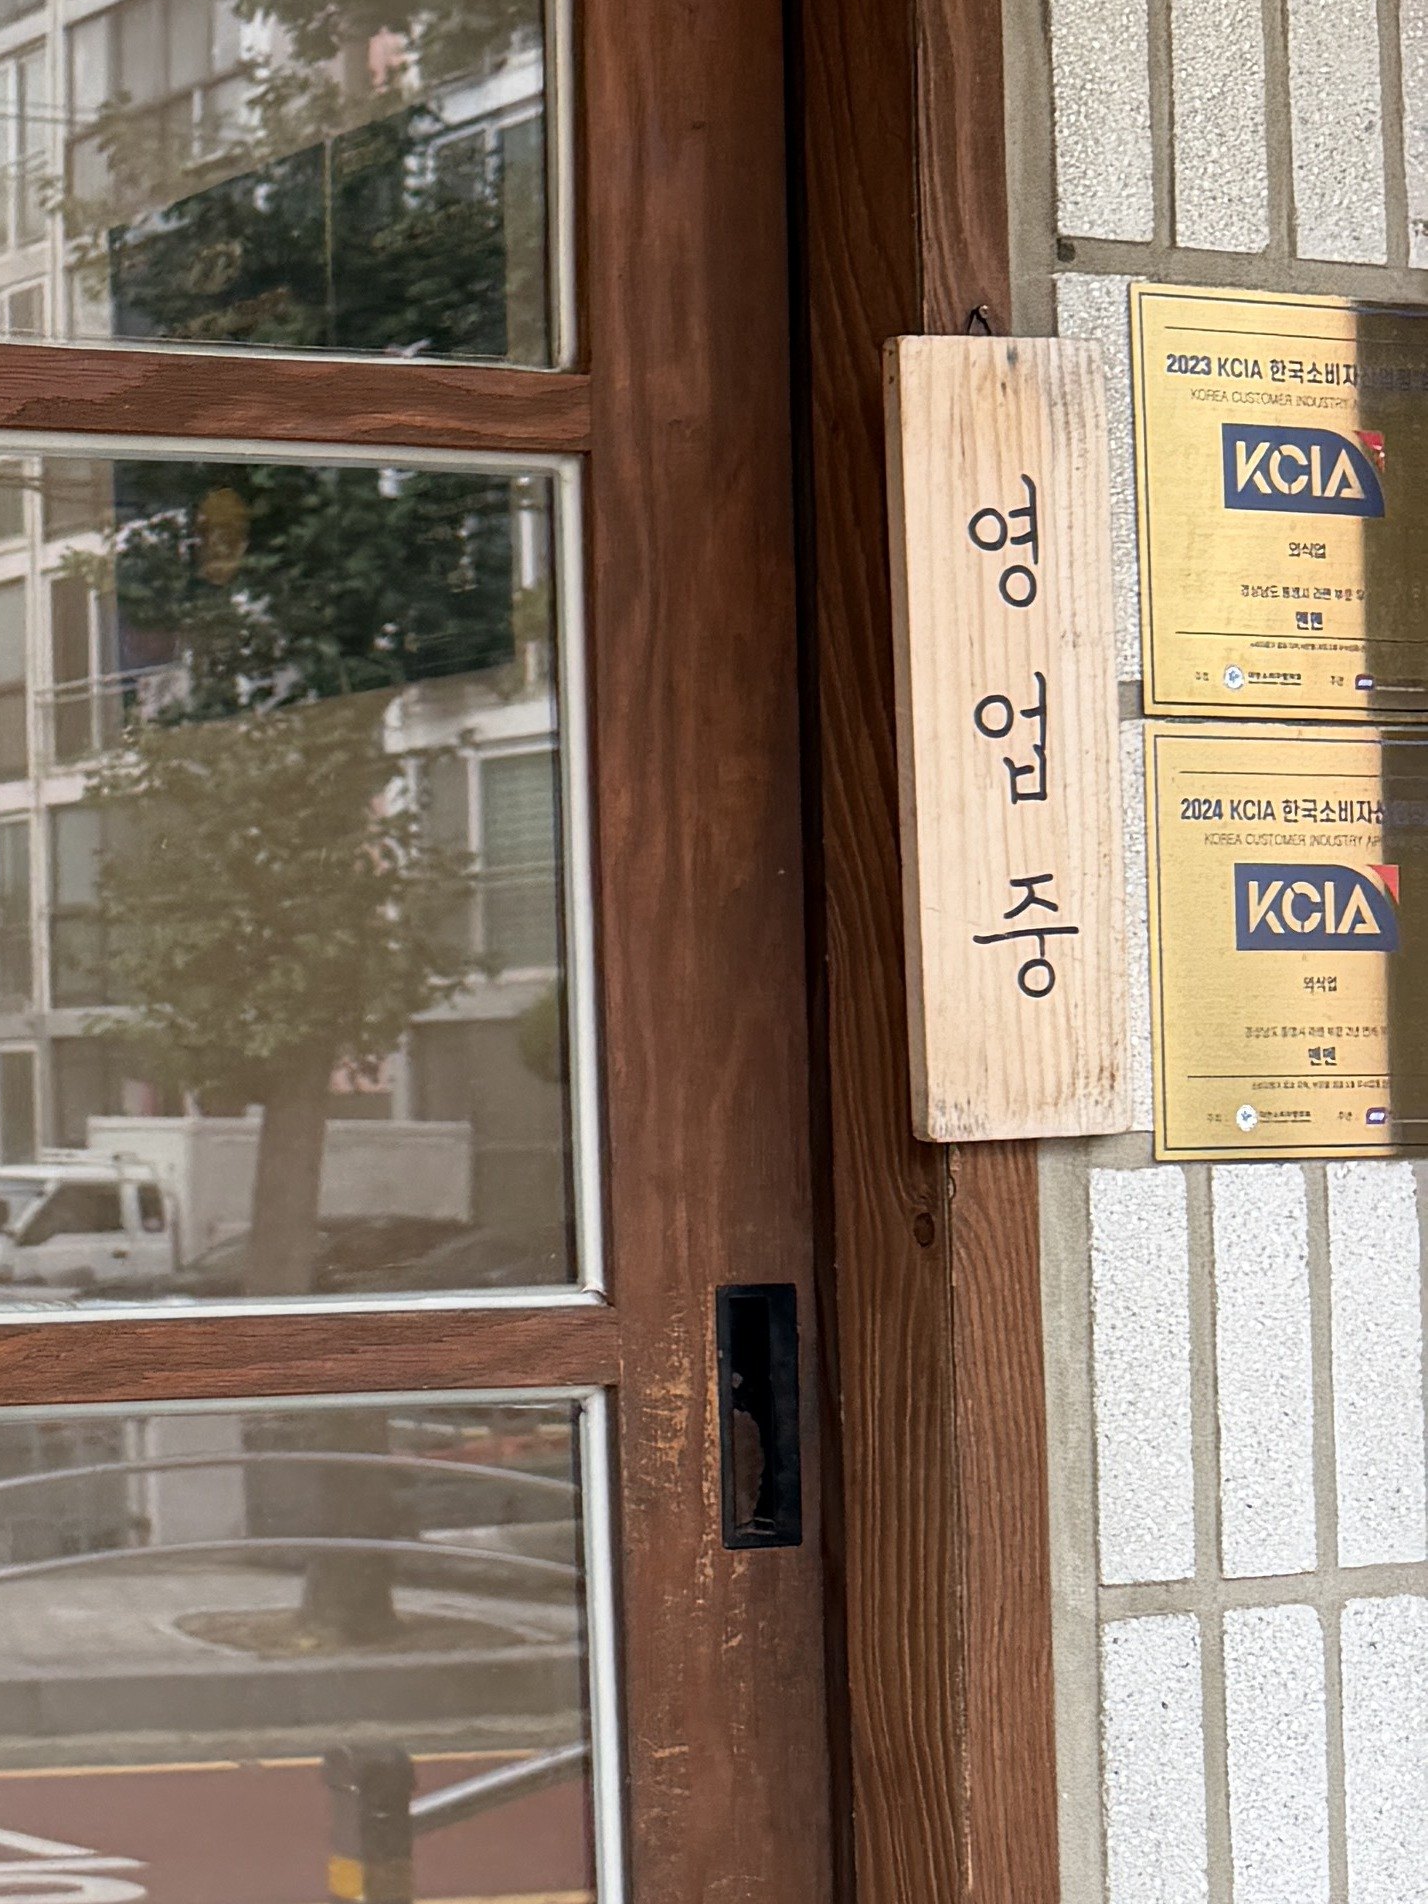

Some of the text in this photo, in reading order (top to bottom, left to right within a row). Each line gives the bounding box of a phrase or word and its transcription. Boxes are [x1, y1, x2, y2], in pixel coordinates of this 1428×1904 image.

[1165, 353, 1212, 376] 2023
[1217, 356, 1263, 380] KCIA
[1190, 388, 1229, 403] KOREA
[1231, 390, 1294, 408] CUSTOMER
[1235, 439, 1366, 500] KCIA
[1288, 541, 1327, 560] 외식업
[967, 473, 1079, 999] 영업중
[1179, 797, 1224, 821] 2024
[1229, 798, 1277, 822] KCIA
[1203, 832, 1243, 846] KOREA
[1244, 832, 1307, 847] CUSTOMER
[1309, 833, 1363, 848] INDUSTRY
[1248, 879, 1381, 935] KCIA
[1303, 975, 1338, 994] 외식업
